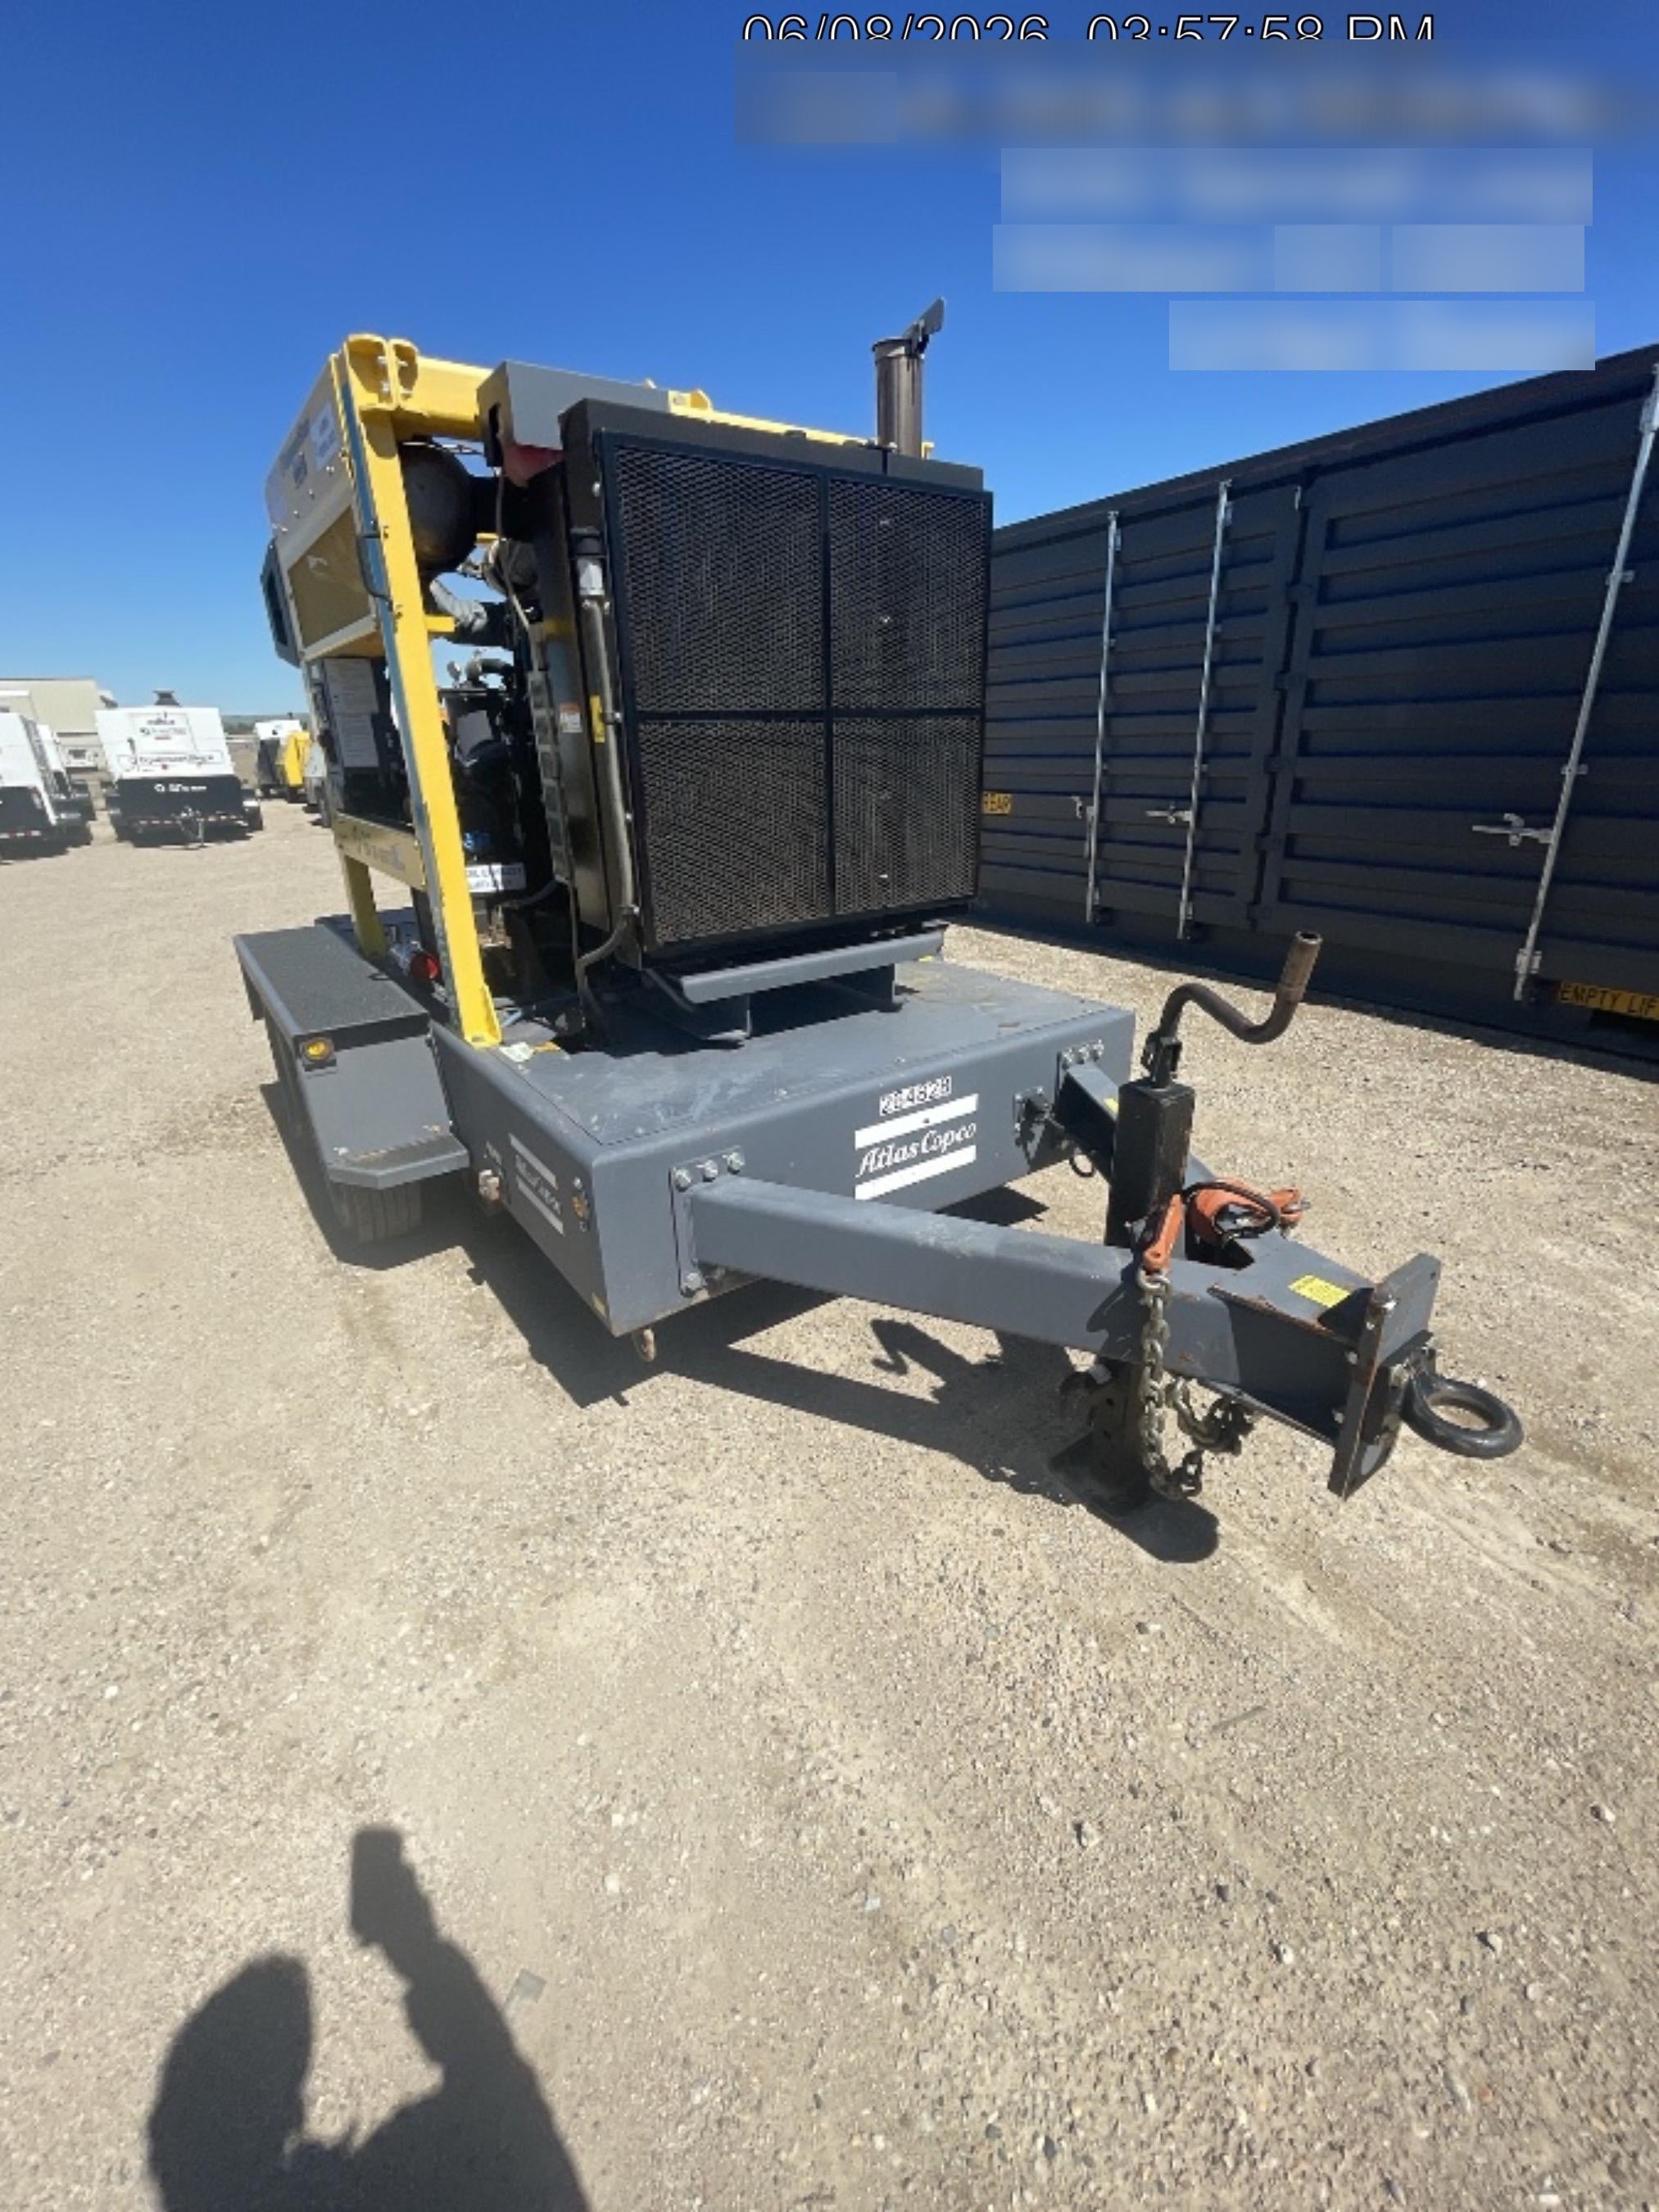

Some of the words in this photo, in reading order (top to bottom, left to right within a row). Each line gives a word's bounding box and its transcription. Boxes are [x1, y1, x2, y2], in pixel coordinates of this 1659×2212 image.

[1560, 983, 1622, 1009] EMPTY
[854, 1143, 919, 1178] Atlas
[921, 1122, 977, 1154] Copco
